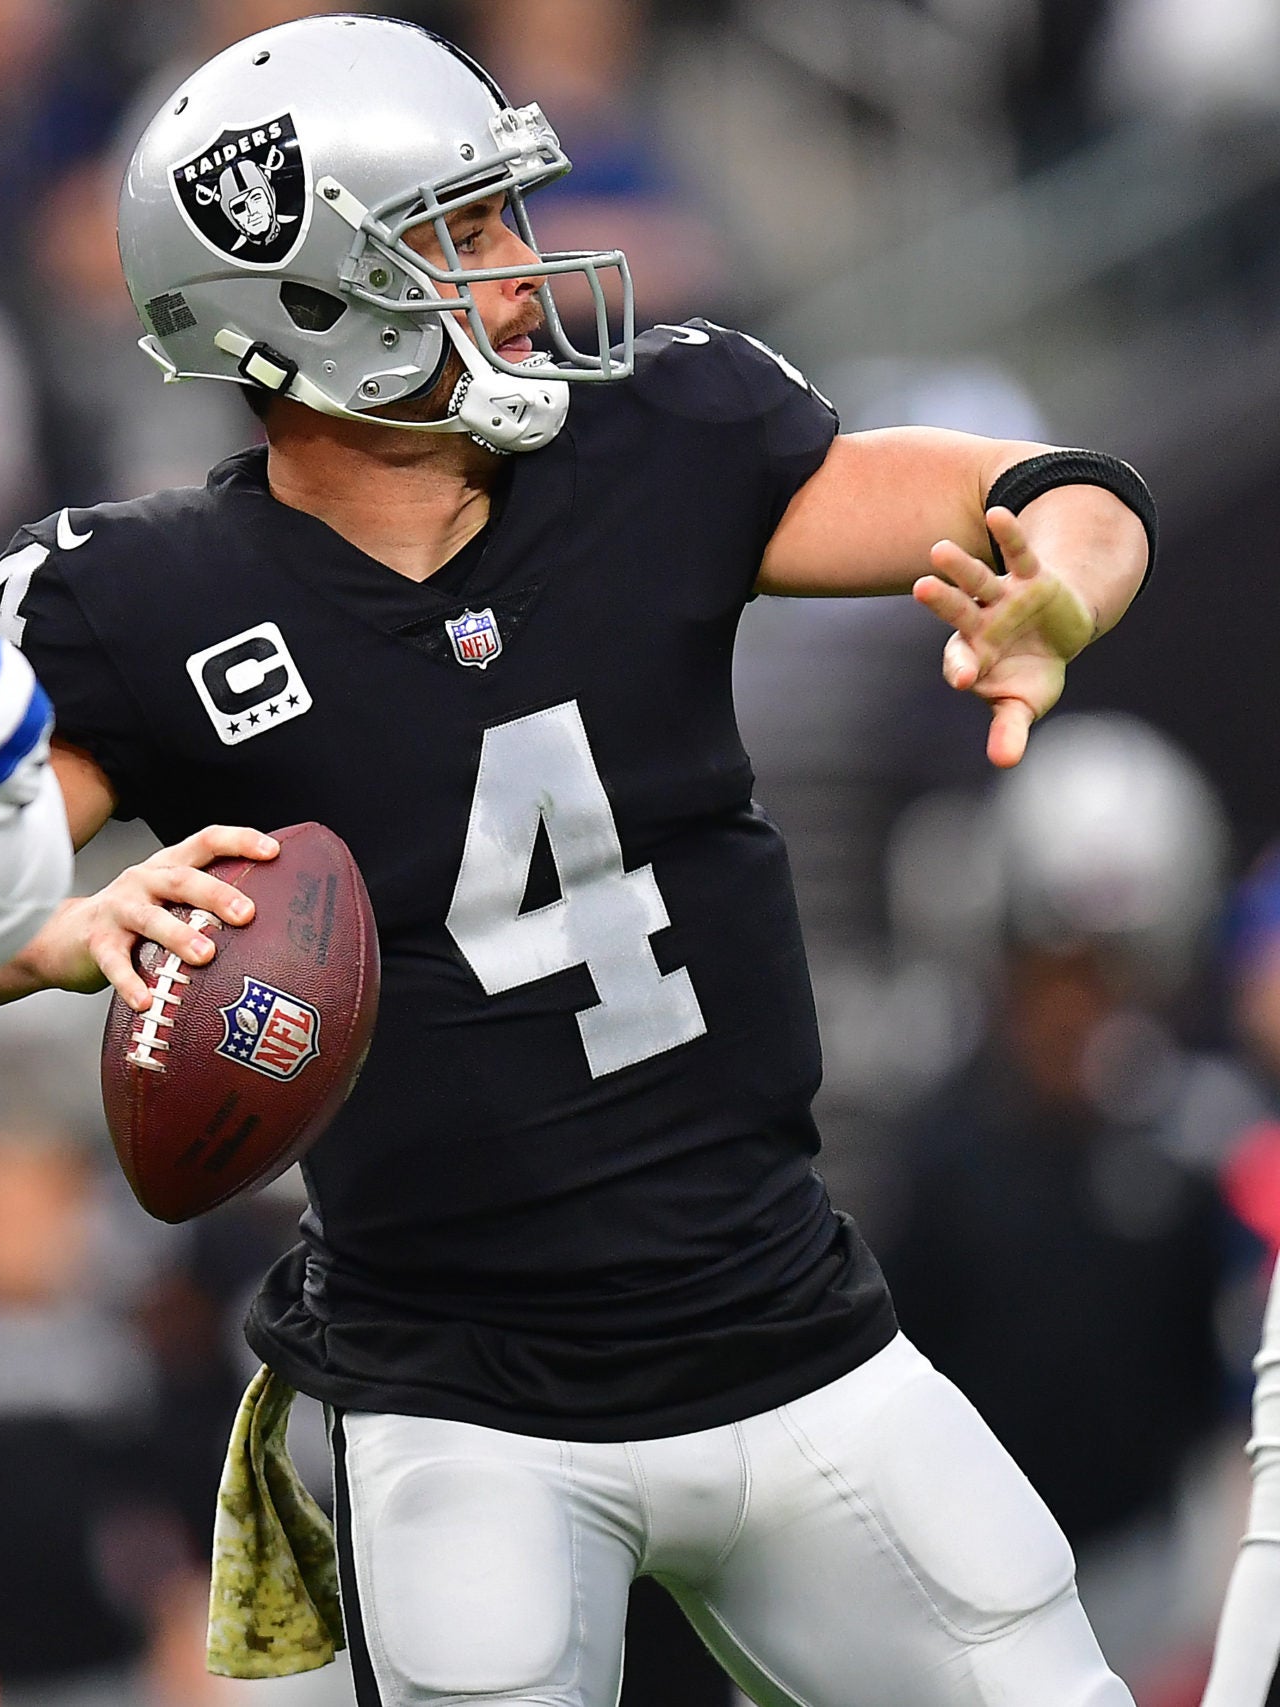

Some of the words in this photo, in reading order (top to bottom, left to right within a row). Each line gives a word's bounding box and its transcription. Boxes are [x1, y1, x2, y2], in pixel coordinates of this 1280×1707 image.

[183, 122, 282, 182] RAIDERS
[202, 636, 289, 715] C
[460, 633, 495, 658] NFL
[446, 699, 707, 1079] 4
[255, 1008, 311, 1072] NFL
